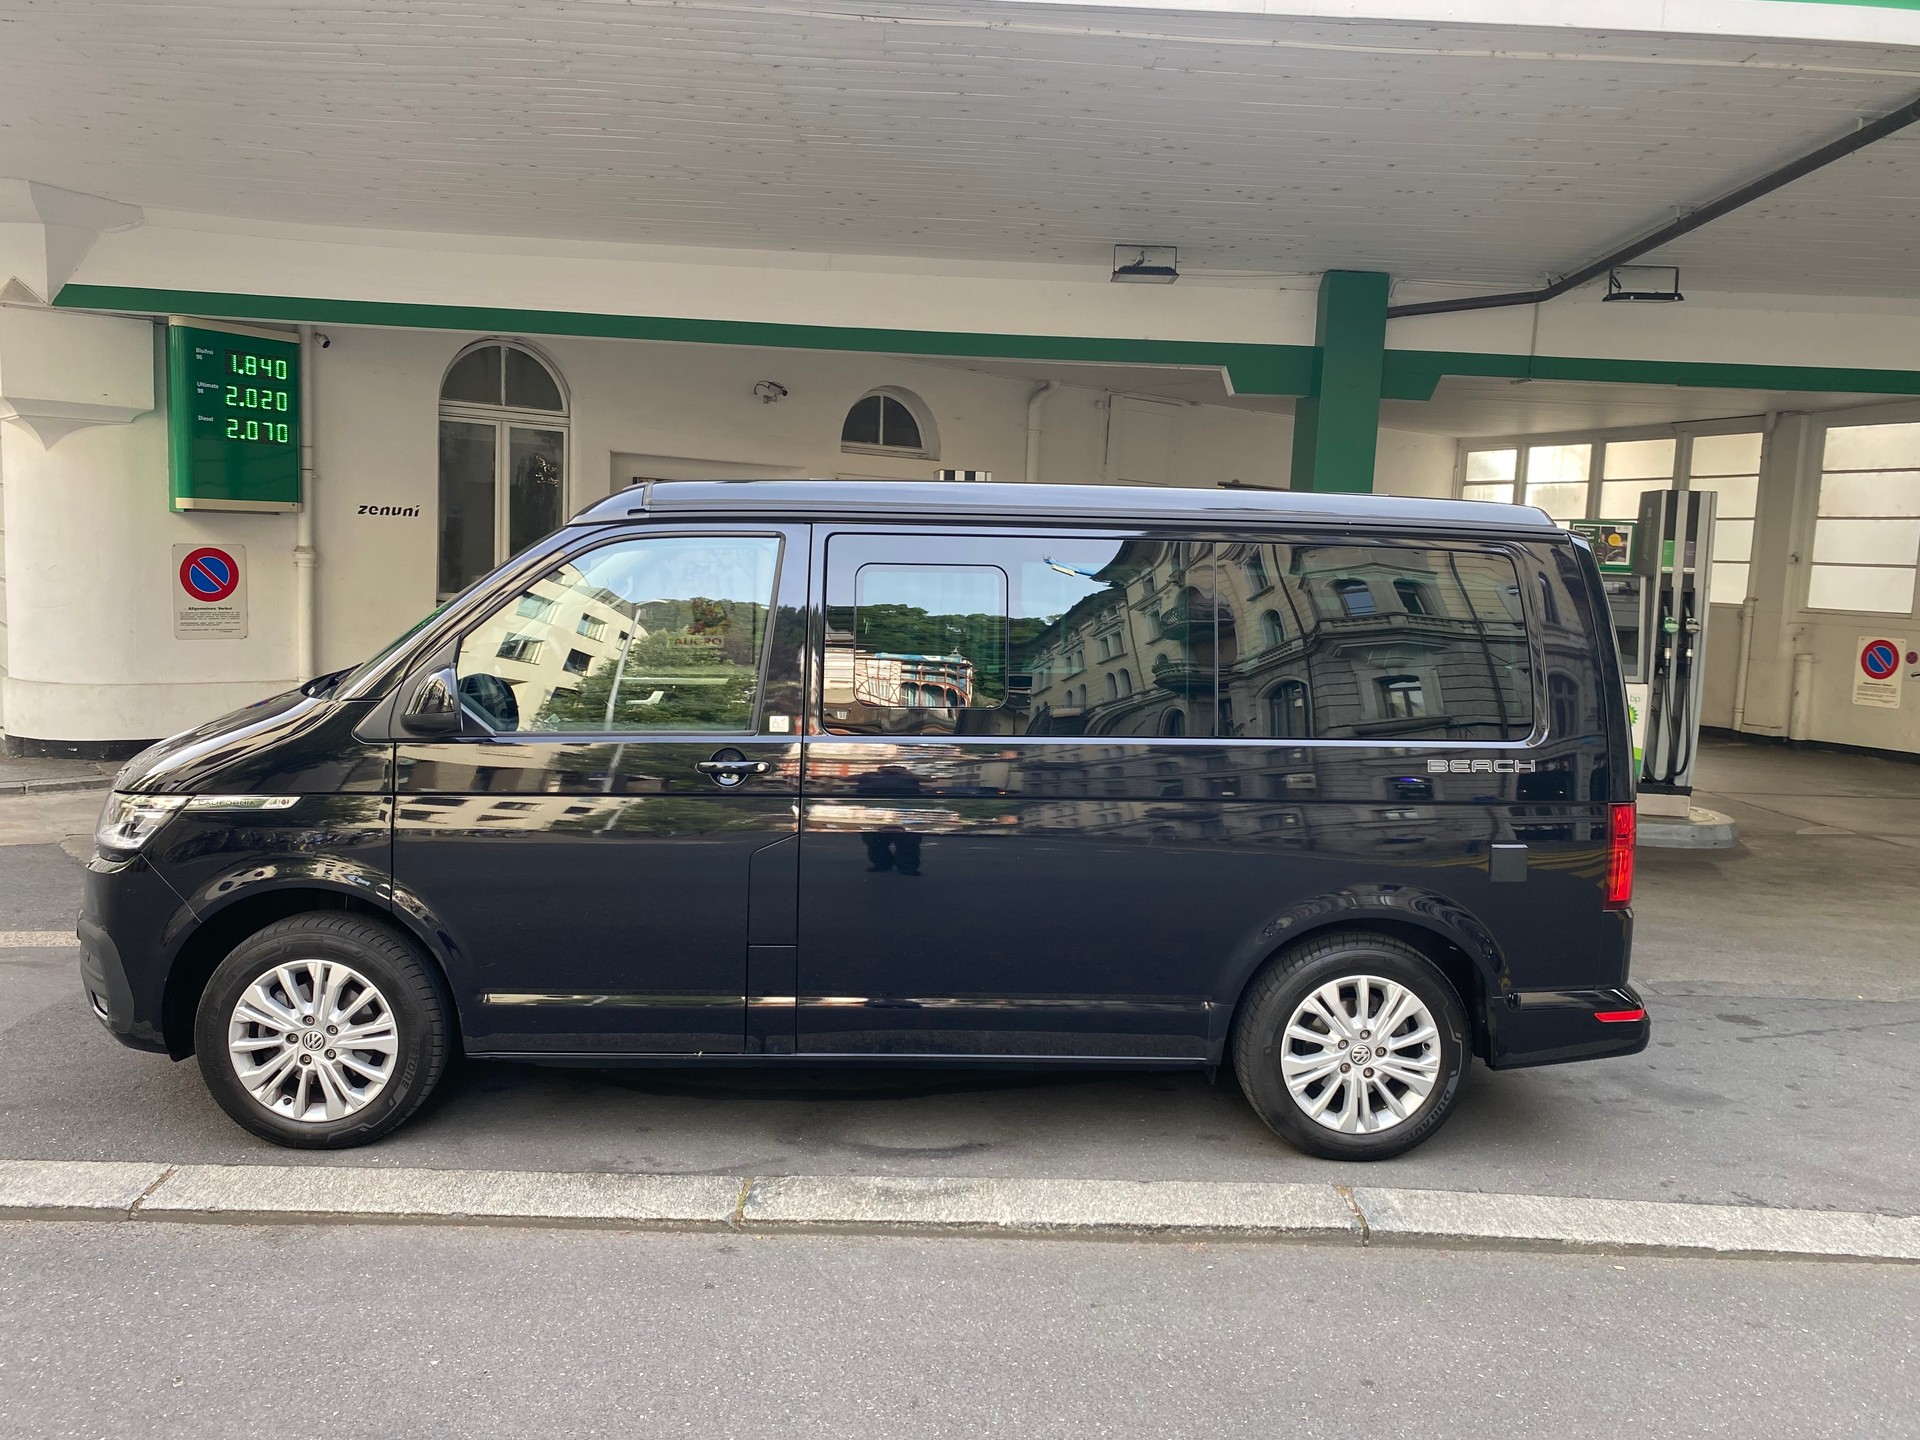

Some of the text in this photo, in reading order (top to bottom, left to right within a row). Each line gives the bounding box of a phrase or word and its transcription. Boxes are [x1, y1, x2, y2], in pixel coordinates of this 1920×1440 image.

[230, 354, 287, 380] 1.840
[197, 381, 219, 389] Ultimate
[225, 385, 288, 412] 2.020
[226, 418, 288, 443] 2.070
[357, 504, 420, 517] zenuni
[1629, 695, 1641, 704] bp
[1427, 759, 1536, 773] BEACH
